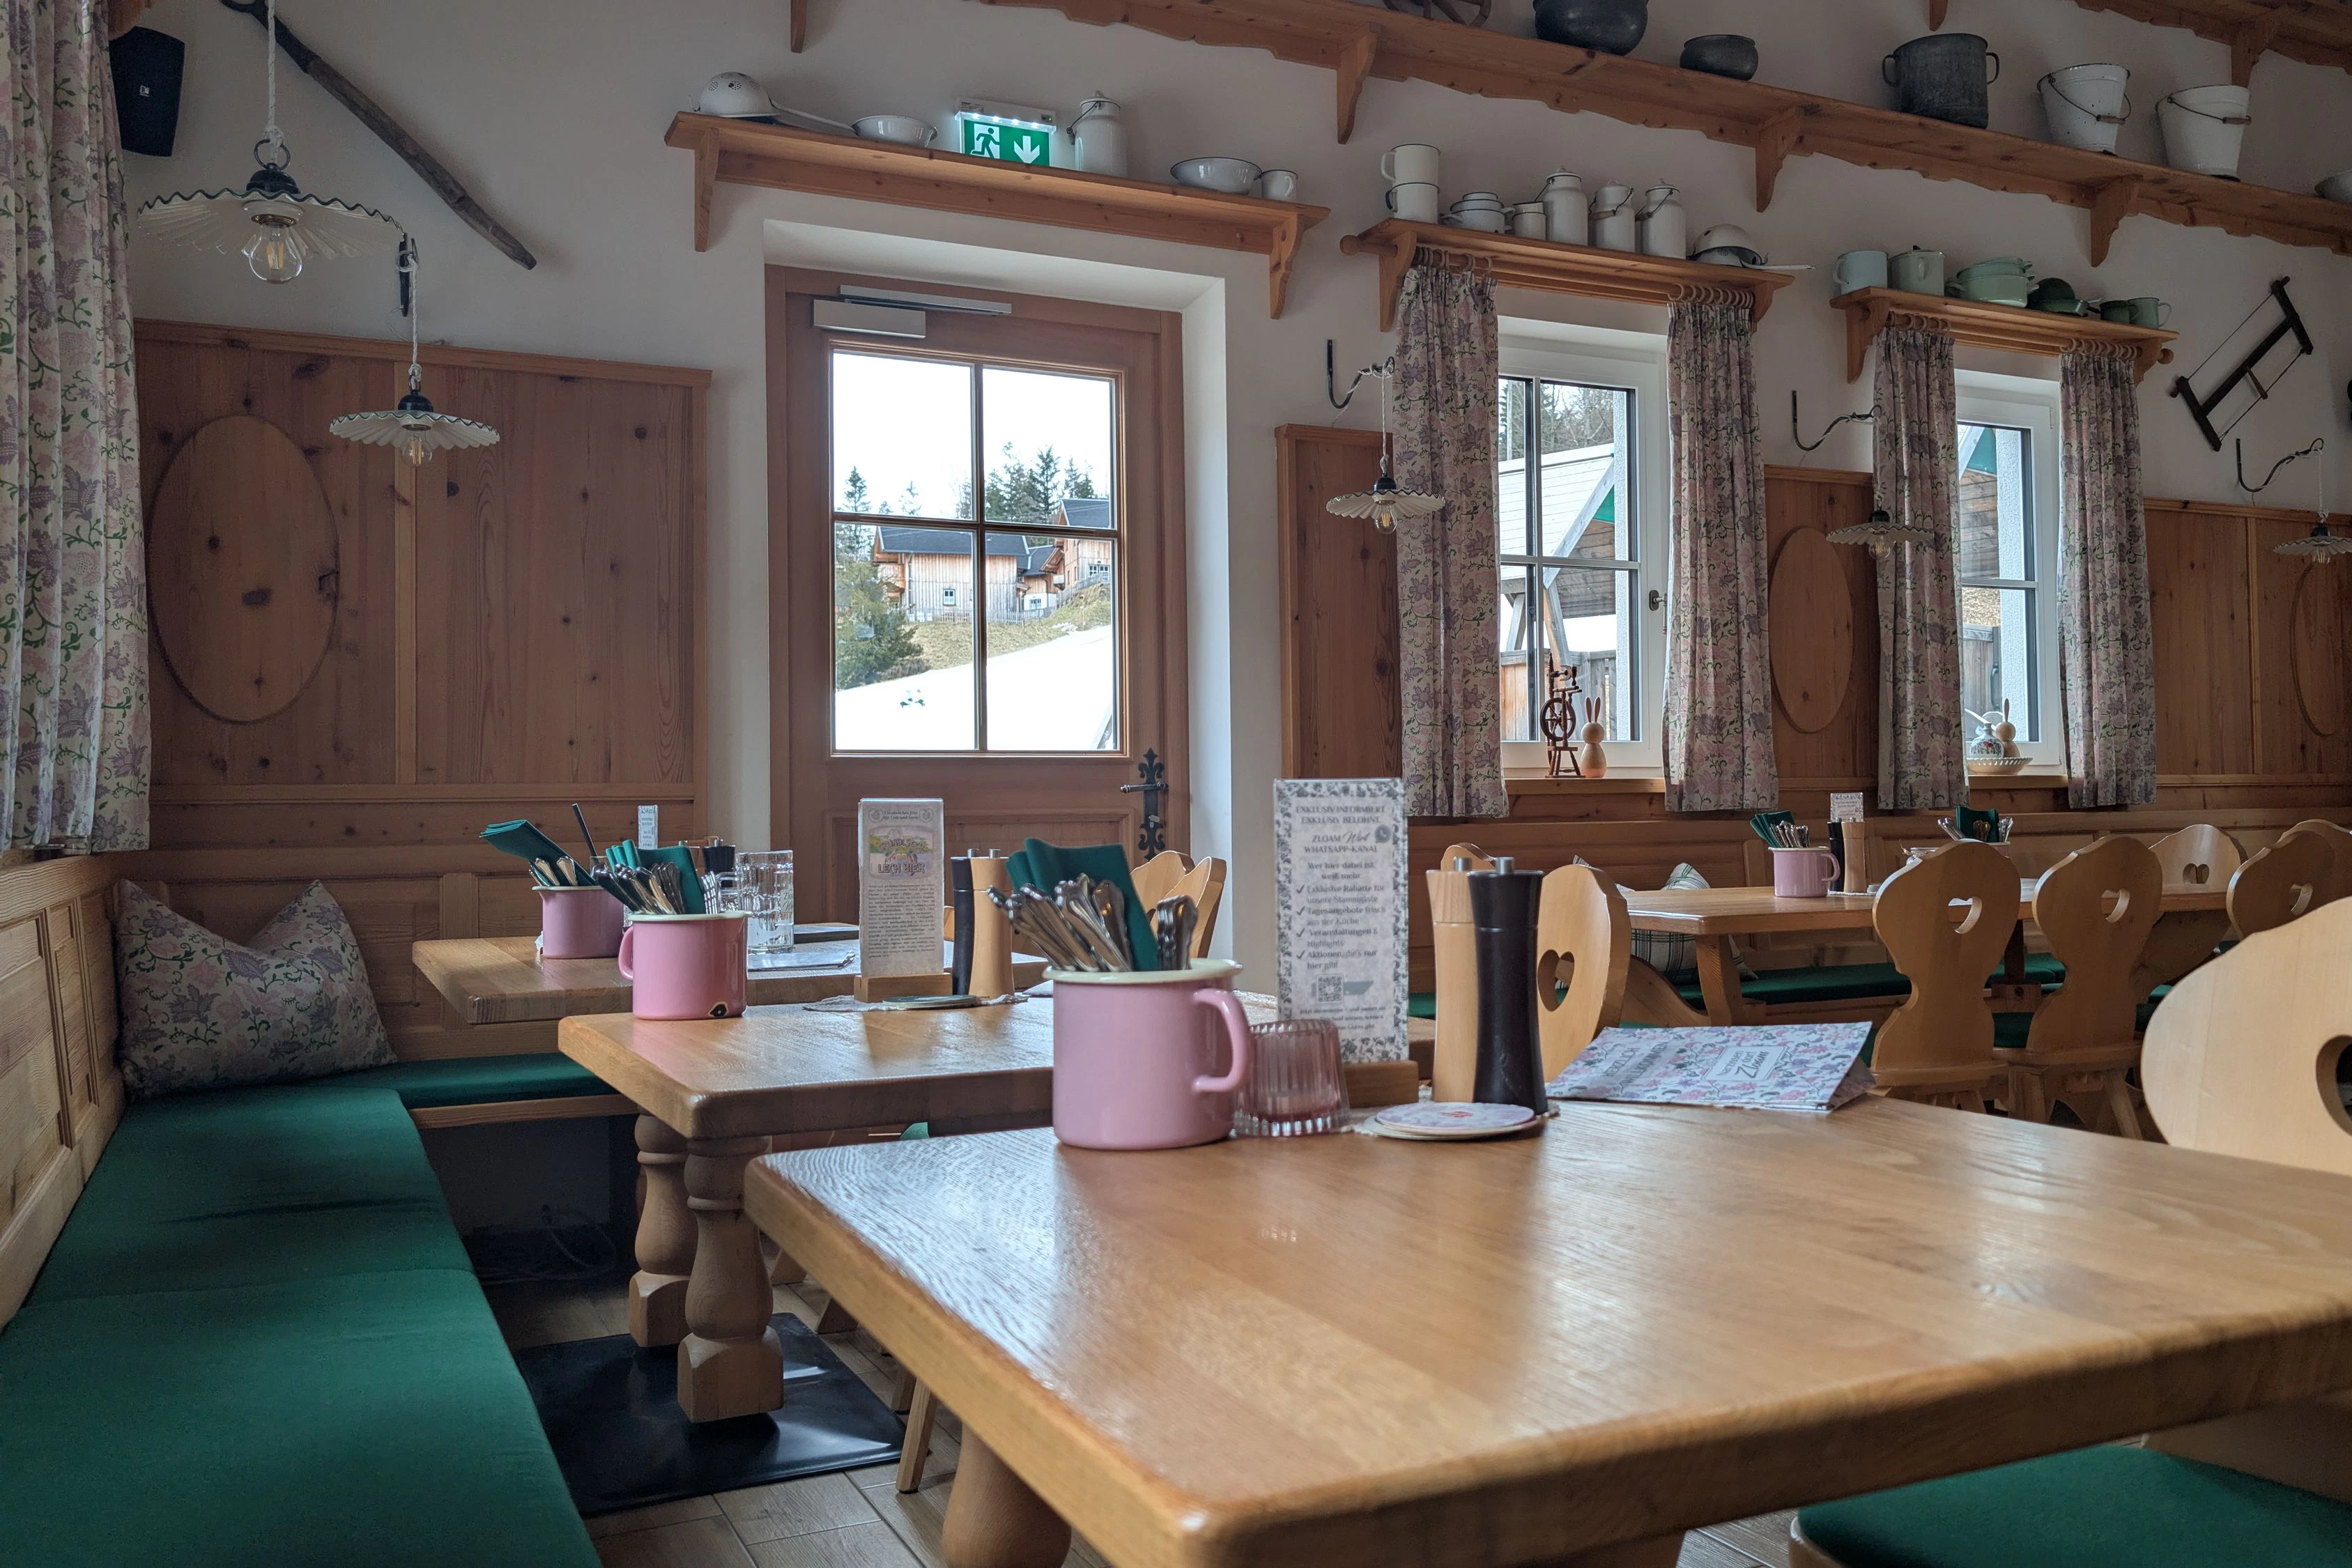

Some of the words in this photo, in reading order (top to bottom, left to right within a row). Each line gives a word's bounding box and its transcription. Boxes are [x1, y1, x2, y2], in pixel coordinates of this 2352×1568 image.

[903, 863, 925, 875] BIER
[1308, 907, 1364, 916] Tagesangebote
[1307, 940, 1344, 948] Highlights
